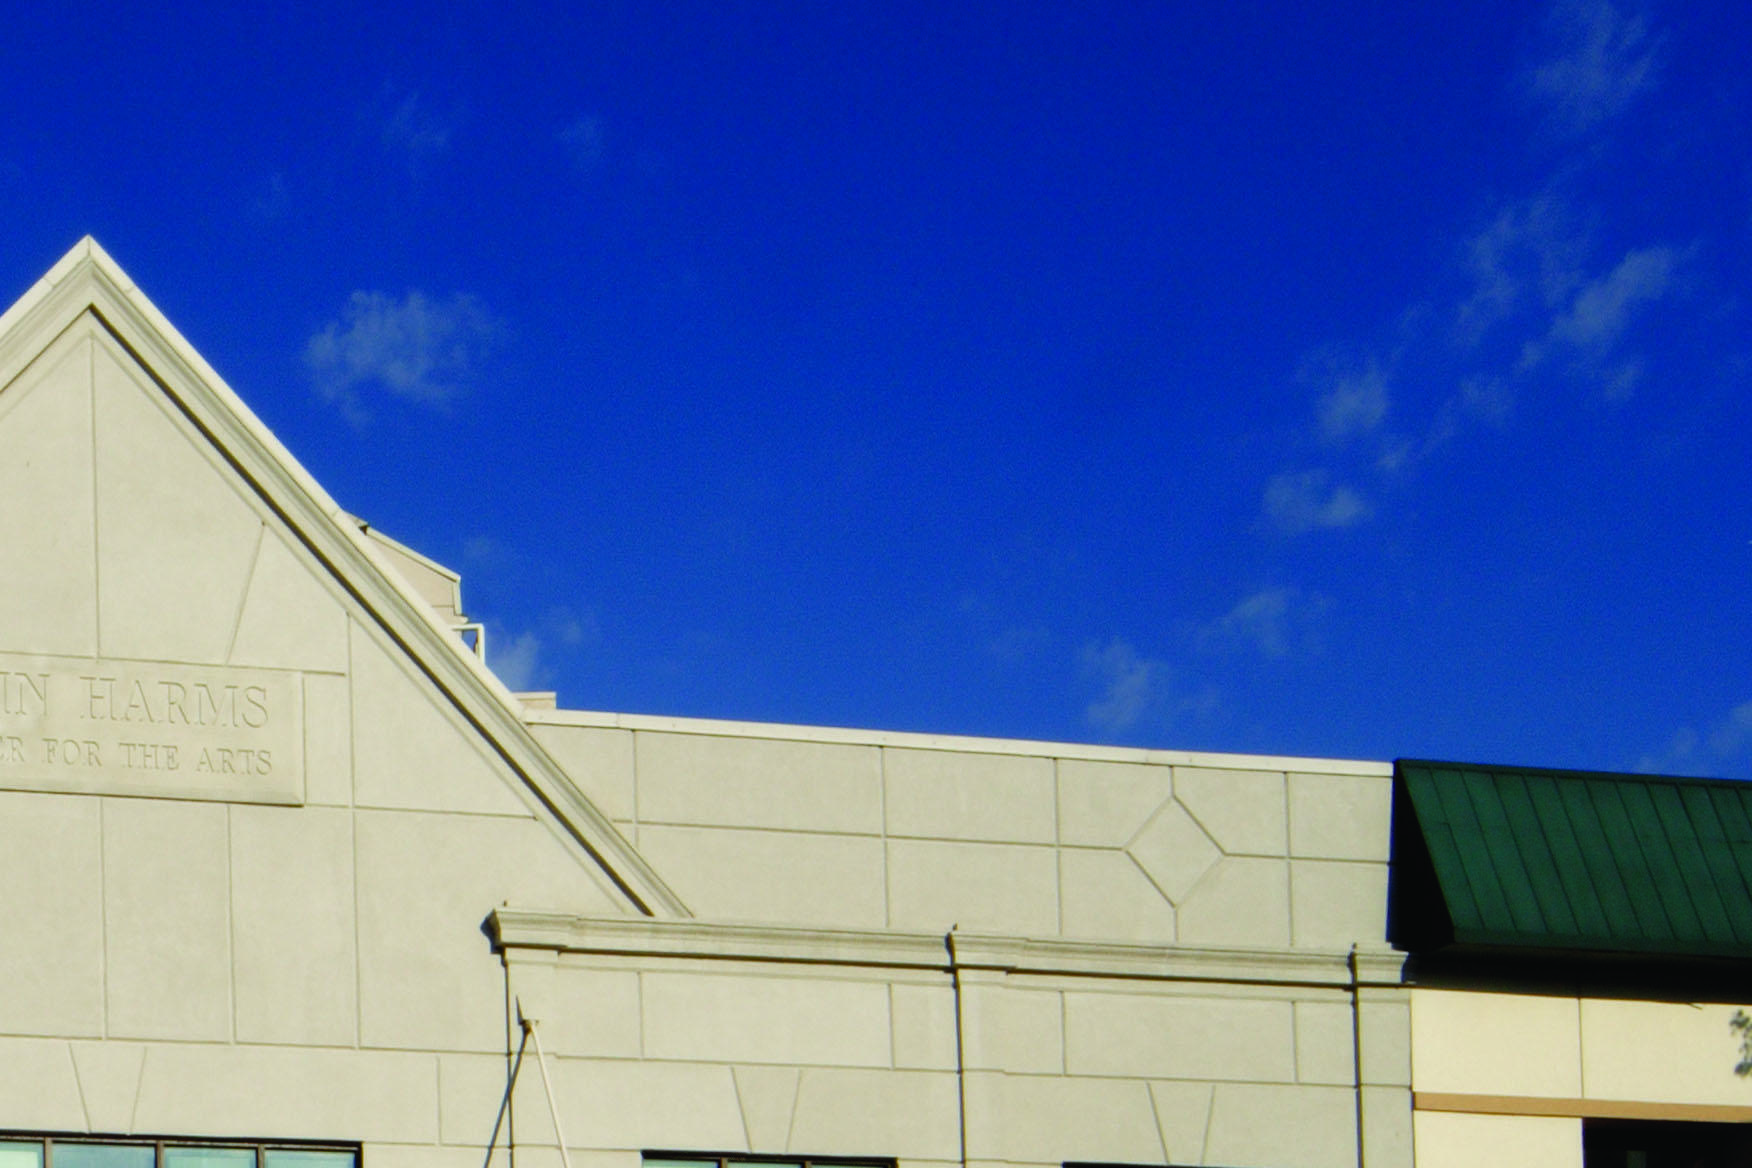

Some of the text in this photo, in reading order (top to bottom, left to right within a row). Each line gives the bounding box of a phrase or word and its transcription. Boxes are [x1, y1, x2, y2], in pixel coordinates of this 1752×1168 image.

[80, 675, 271, 729] HARMS
[42, 738, 103, 768] FOR
[120, 742, 180, 771] THE
[195, 748, 273, 776] ARTS
